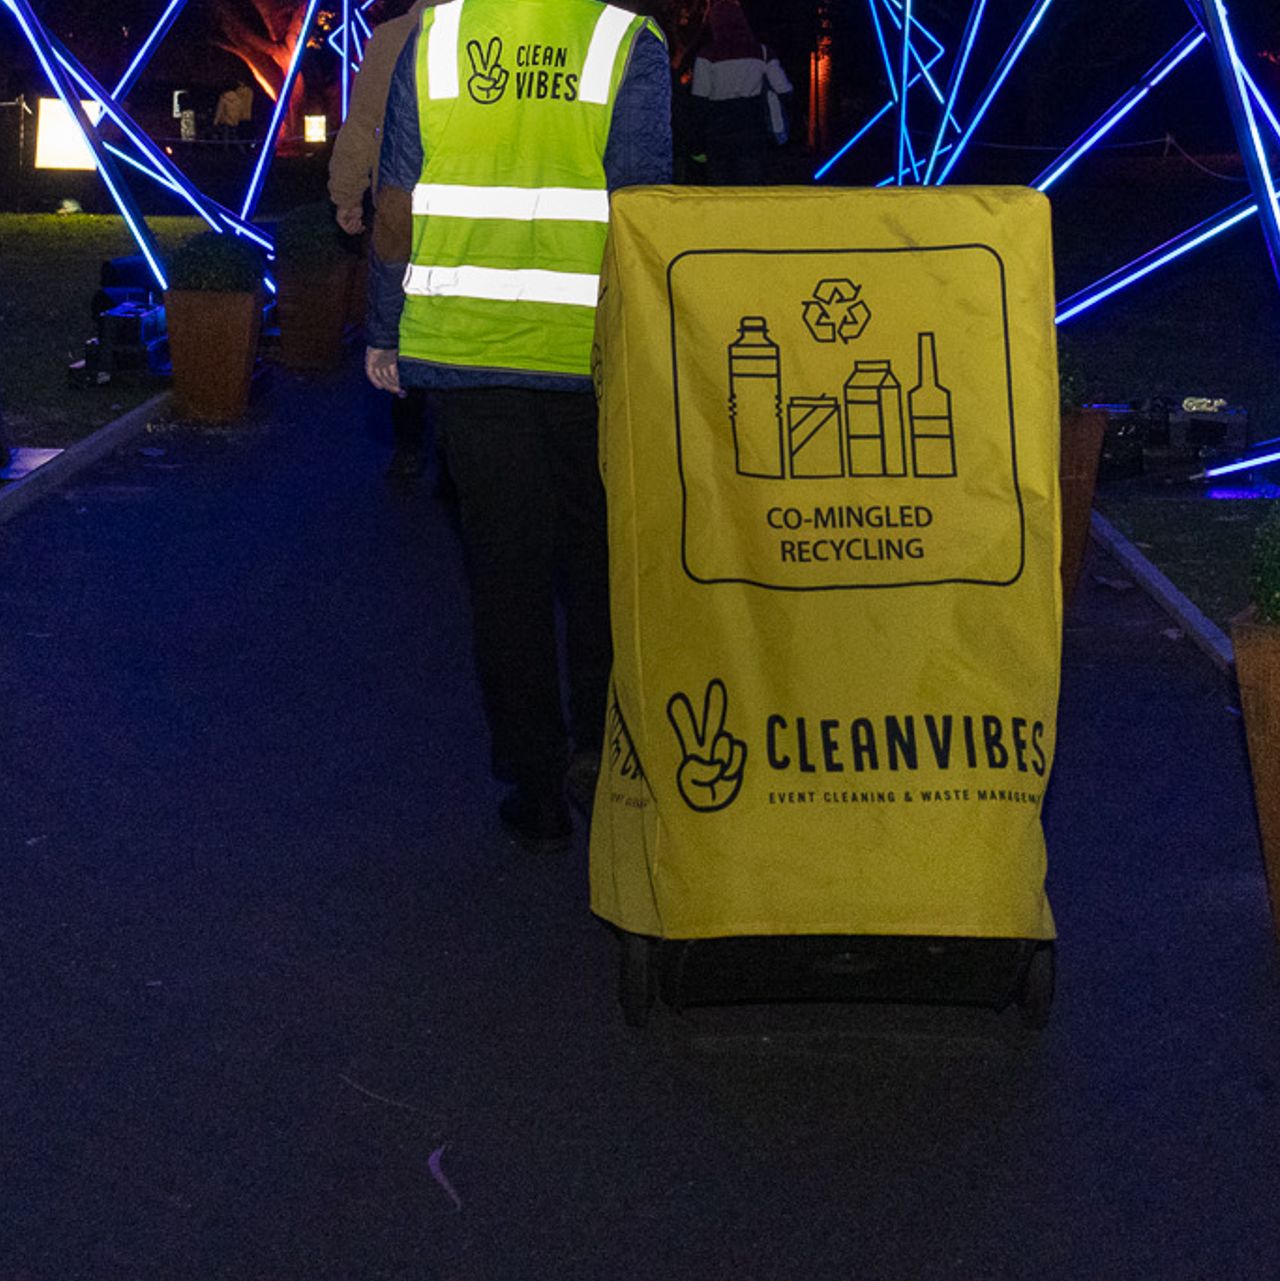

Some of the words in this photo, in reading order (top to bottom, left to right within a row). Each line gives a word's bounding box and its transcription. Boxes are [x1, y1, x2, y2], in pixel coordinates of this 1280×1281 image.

[516, 44, 568, 67] CLEAN
[516, 70, 578, 102] VIBES
[766, 505, 933, 530] CO-MINGLED
[781, 538, 924, 562] RECYCLING
[766, 713, 1046, 777] CLEANVIBES
[769, 791, 815, 804] EVENT
[823, 791, 896, 802] CLEANING
[904, 790, 913, 802] &
[921, 790, 970, 801] WASTE
[977, 789, 1042, 803] MANAGEM
